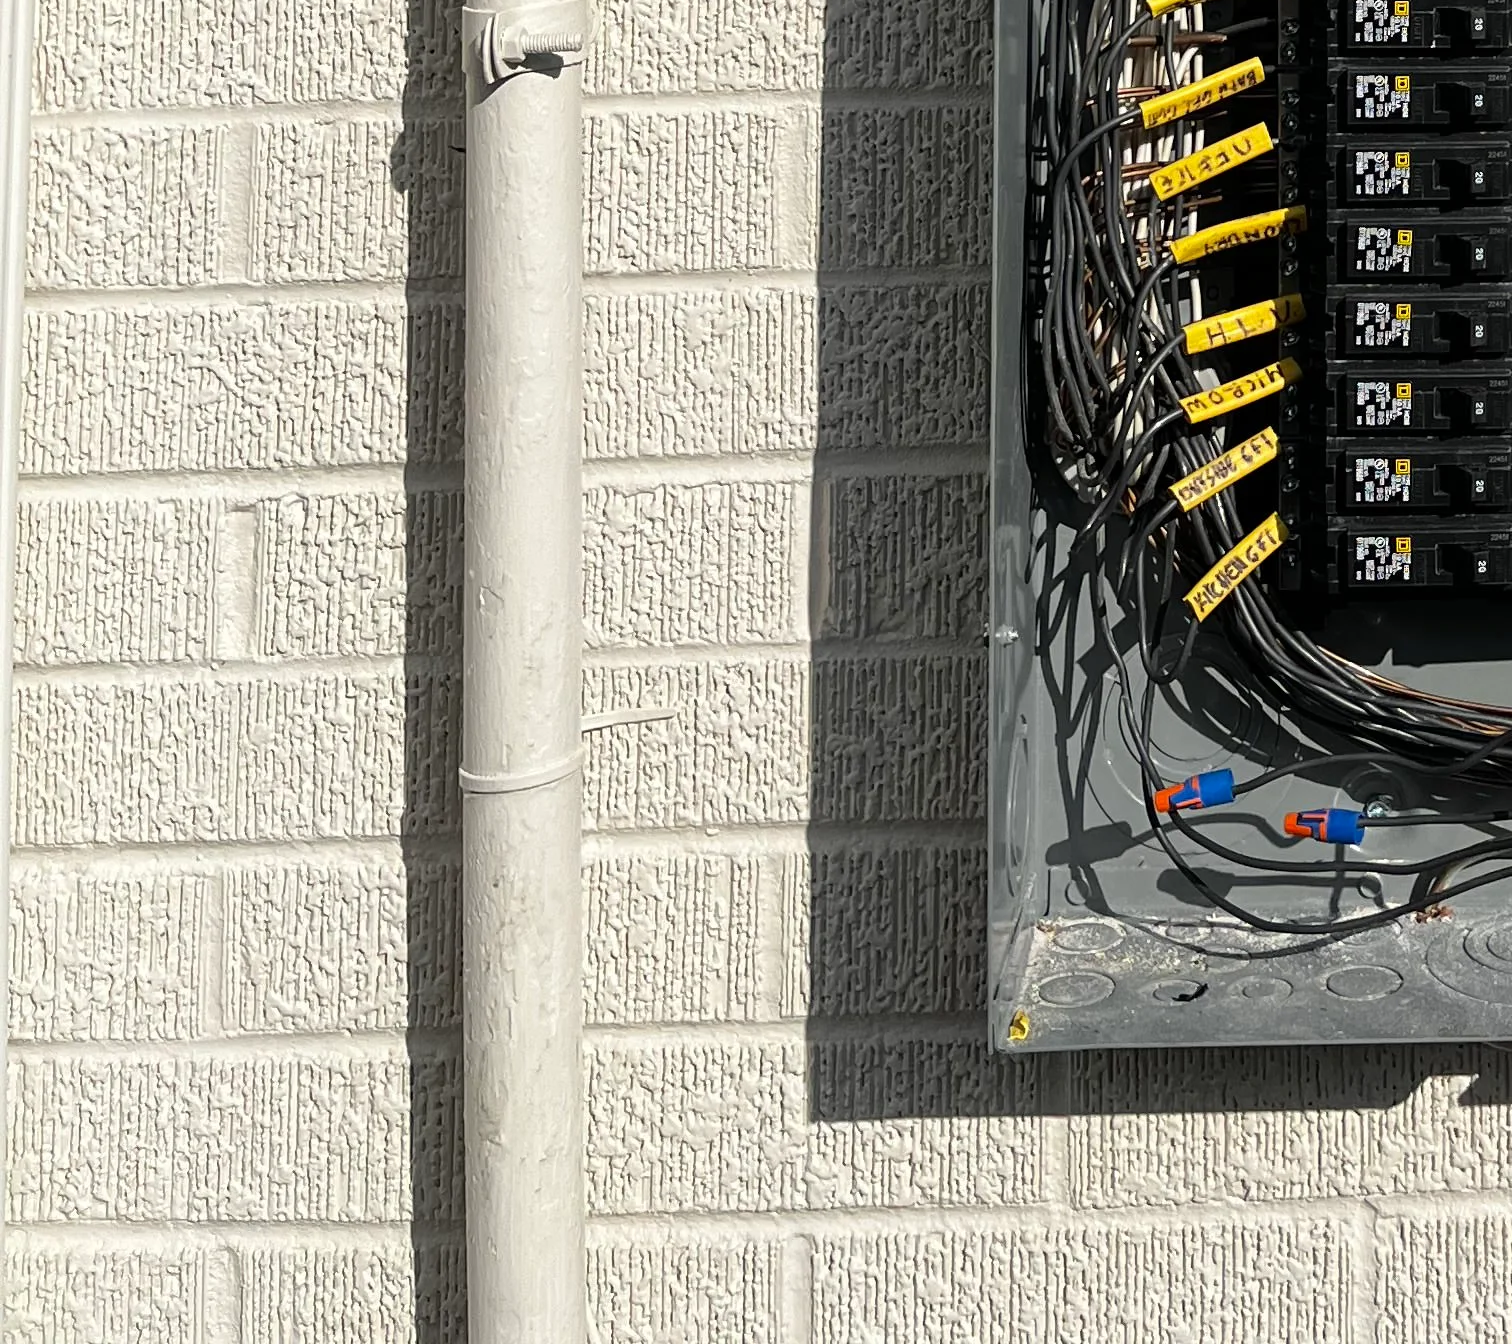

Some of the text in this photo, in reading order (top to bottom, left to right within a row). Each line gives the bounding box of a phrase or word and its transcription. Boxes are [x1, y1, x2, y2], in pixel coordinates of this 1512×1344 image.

[1474, 18, 1484, 31] 20
[1474, 94, 1484, 107] 20
[1474, 171, 1484, 184] 20
[1475, 247, 1484, 261] 20
[1475, 324, 1484, 338] 20
[1475, 402, 1484, 415] 20
[1475, 479, 1485, 493] 20
[1478, 560, 1487, 573] 20
